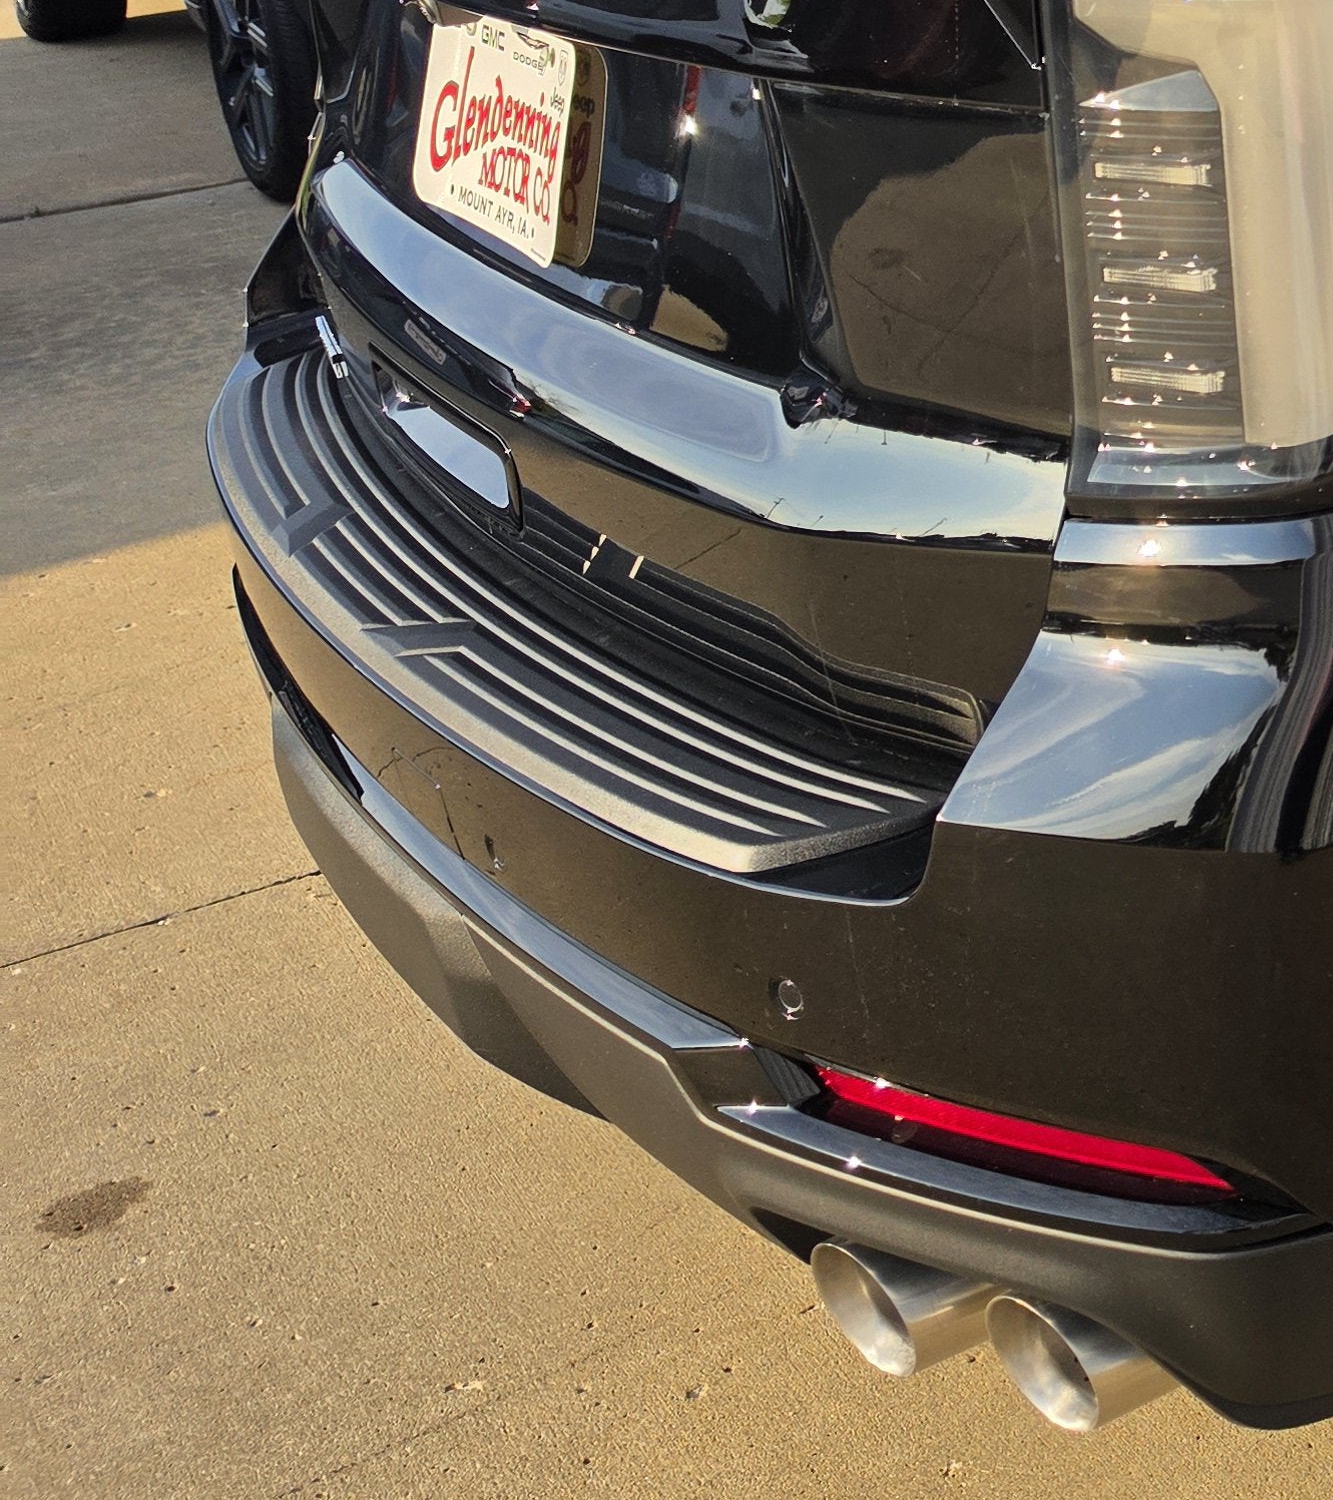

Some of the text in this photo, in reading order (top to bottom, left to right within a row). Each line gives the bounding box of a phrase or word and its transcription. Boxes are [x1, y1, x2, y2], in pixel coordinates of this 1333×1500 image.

[481, 23, 505, 52] GMC
[429, 45, 561, 184] Glendenning
[477, 145, 531, 214] MOTOR
[458, 185, 494, 216] MOUNT
[495, 204, 515, 234] AYR,
